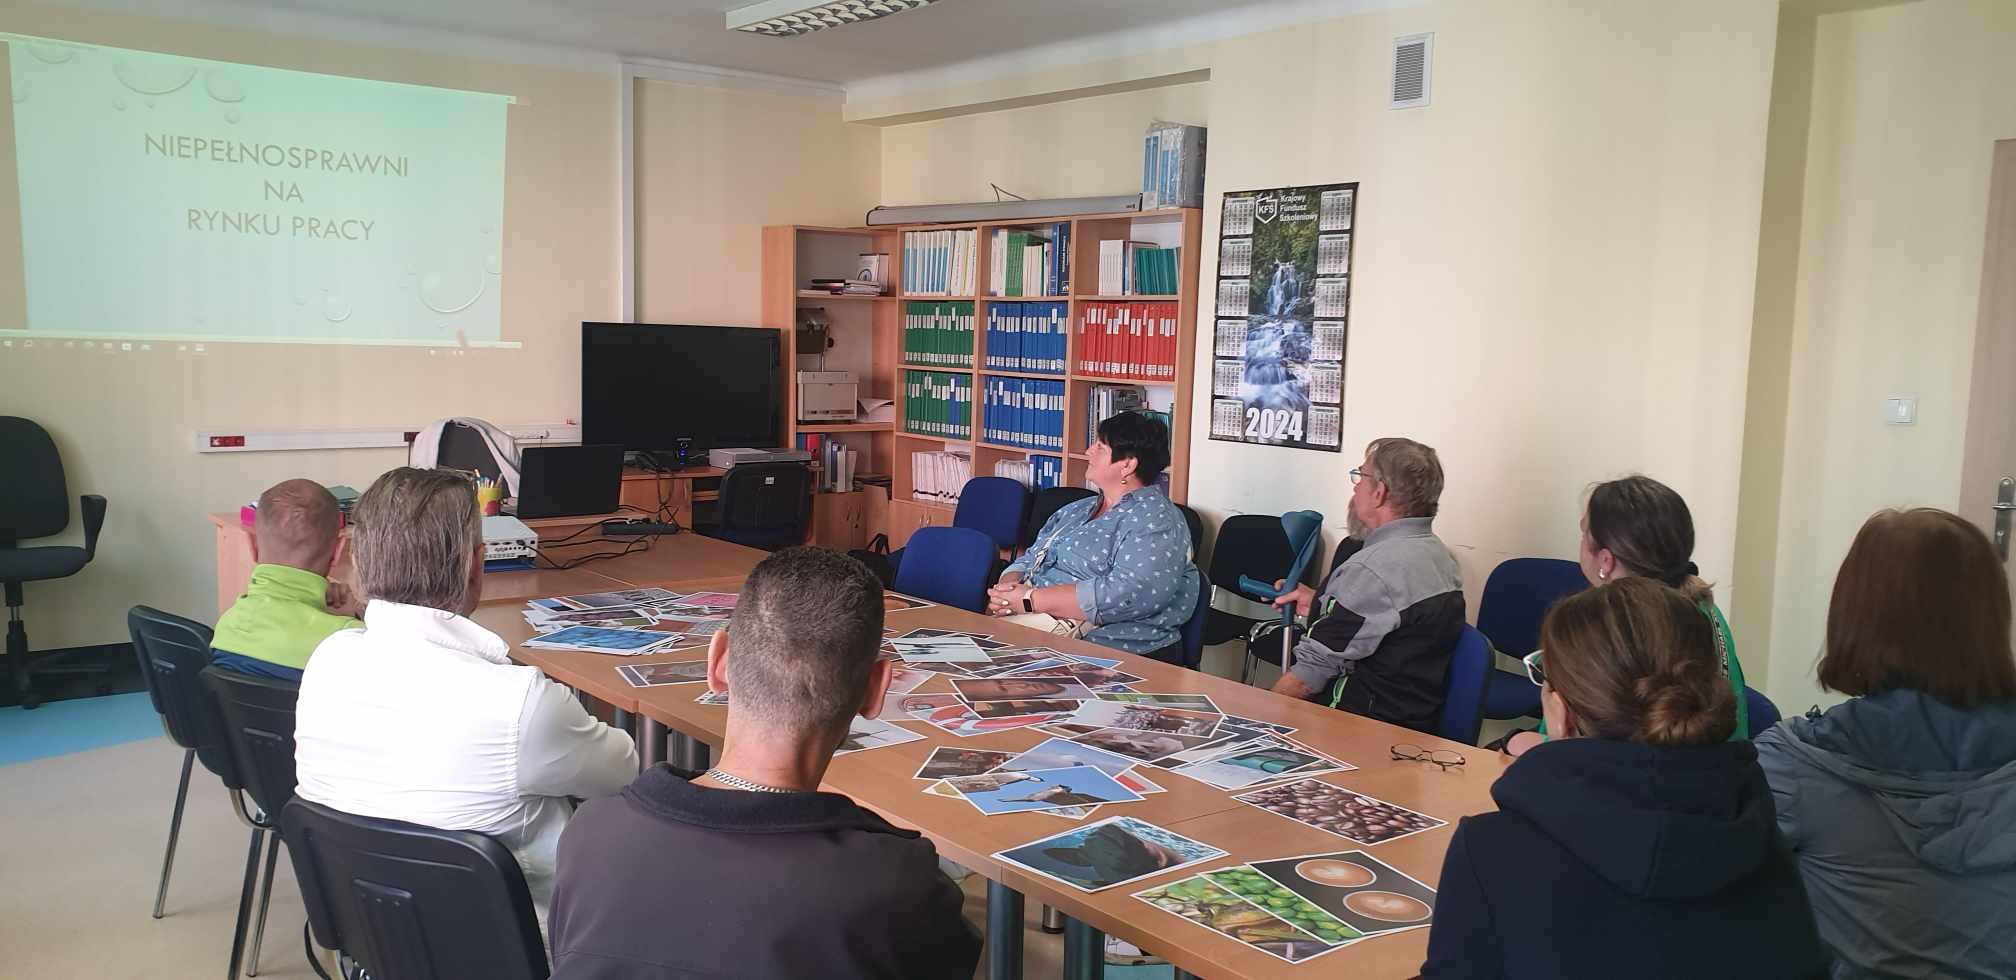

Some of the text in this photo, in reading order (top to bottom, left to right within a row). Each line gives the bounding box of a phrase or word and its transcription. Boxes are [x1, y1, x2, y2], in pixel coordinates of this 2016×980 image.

[144, 133, 408, 177] NIEPEŁNOSPRAWNI
[263, 180, 304, 203] NA
[1280, 194, 1306, 203] Krajowy
[1258, 205, 1274, 214] KFS
[187, 208, 375, 241] RYNKU PRACY
[1245, 407, 1303, 441] 2024
